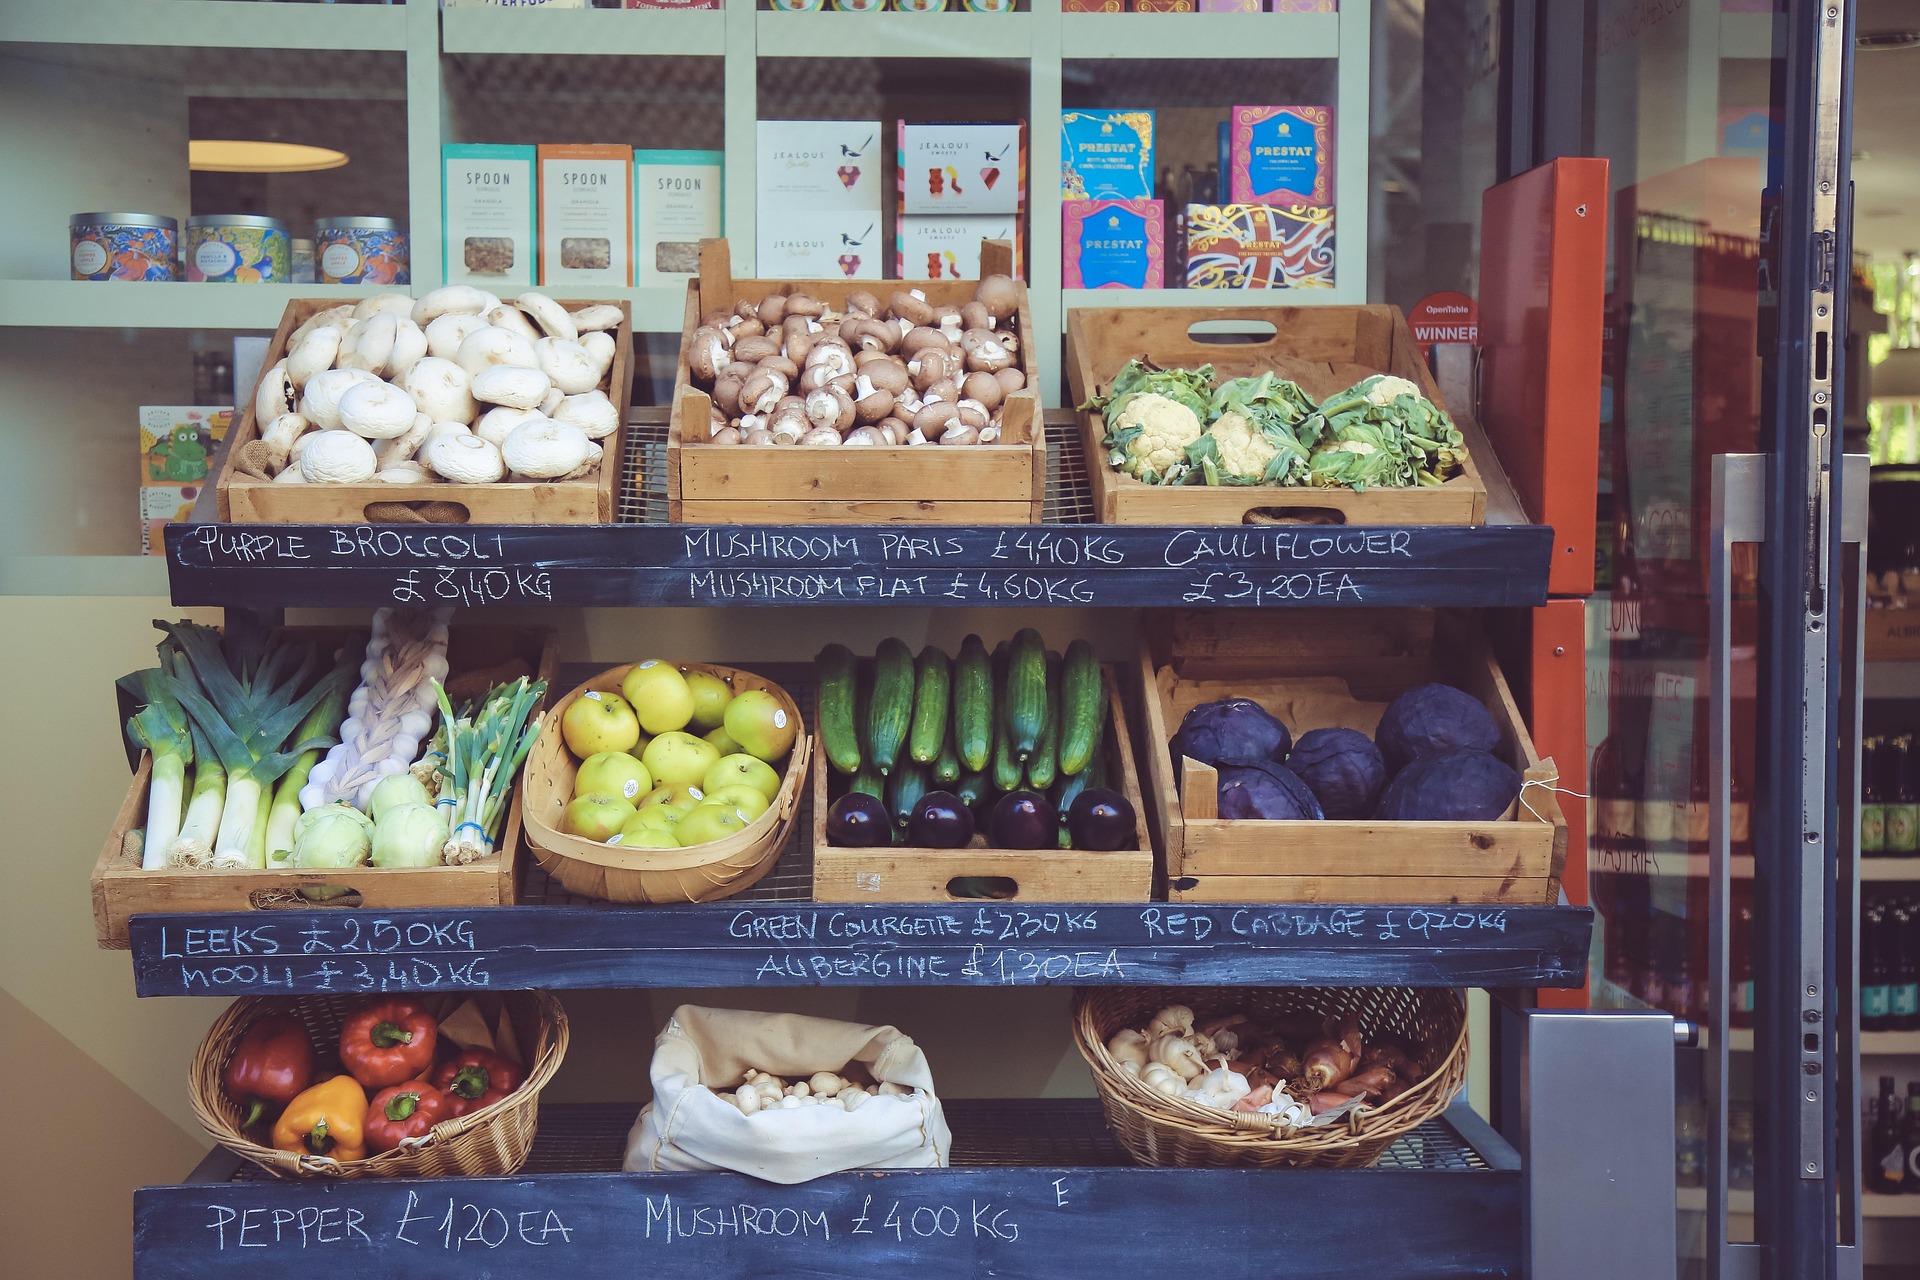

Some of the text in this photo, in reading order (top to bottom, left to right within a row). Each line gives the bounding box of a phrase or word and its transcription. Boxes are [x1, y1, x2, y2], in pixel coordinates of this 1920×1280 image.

[773, 151, 825, 160] JEALOUS
[920, 142, 969, 150] JEALOUS
[1079, 143, 1136, 153] PRESTAT
[1255, 146, 1313, 157] PRESTAT
[466, 172, 511, 185] SPOON
[563, 172, 608, 186] SPOON
[658, 177, 702, 190] SPOON
[917, 227, 968, 235] JEALOUS
[773, 240, 825, 249] JEALOUS
[1085, 239, 1144, 250] PRESTAT
[1426, 305, 1469, 315] OpenTable
[194, 525, 504, 562] PURPLE BROCCOLI
[685, 528, 859, 561] MUSHROOM
[878, 533, 964, 561] PARIS
[1164, 529, 1413, 567] CAULIFLOWER
[689, 570, 850, 599] MUSHROOM
[857, 575, 928, 598] FLAT
[729, 909, 818, 940] GREEN
[1140, 908, 1213, 941] RED
[1231, 908, 1366, 938] CABBAGE
[161, 925, 280, 960] LEEKS
[756, 950, 952, 981] AUBERGINE
[1052, 1176, 1069, 1207] E
[206, 1204, 372, 1251] PEPPER
[645, 1193, 831, 1244] MUSHROOM
